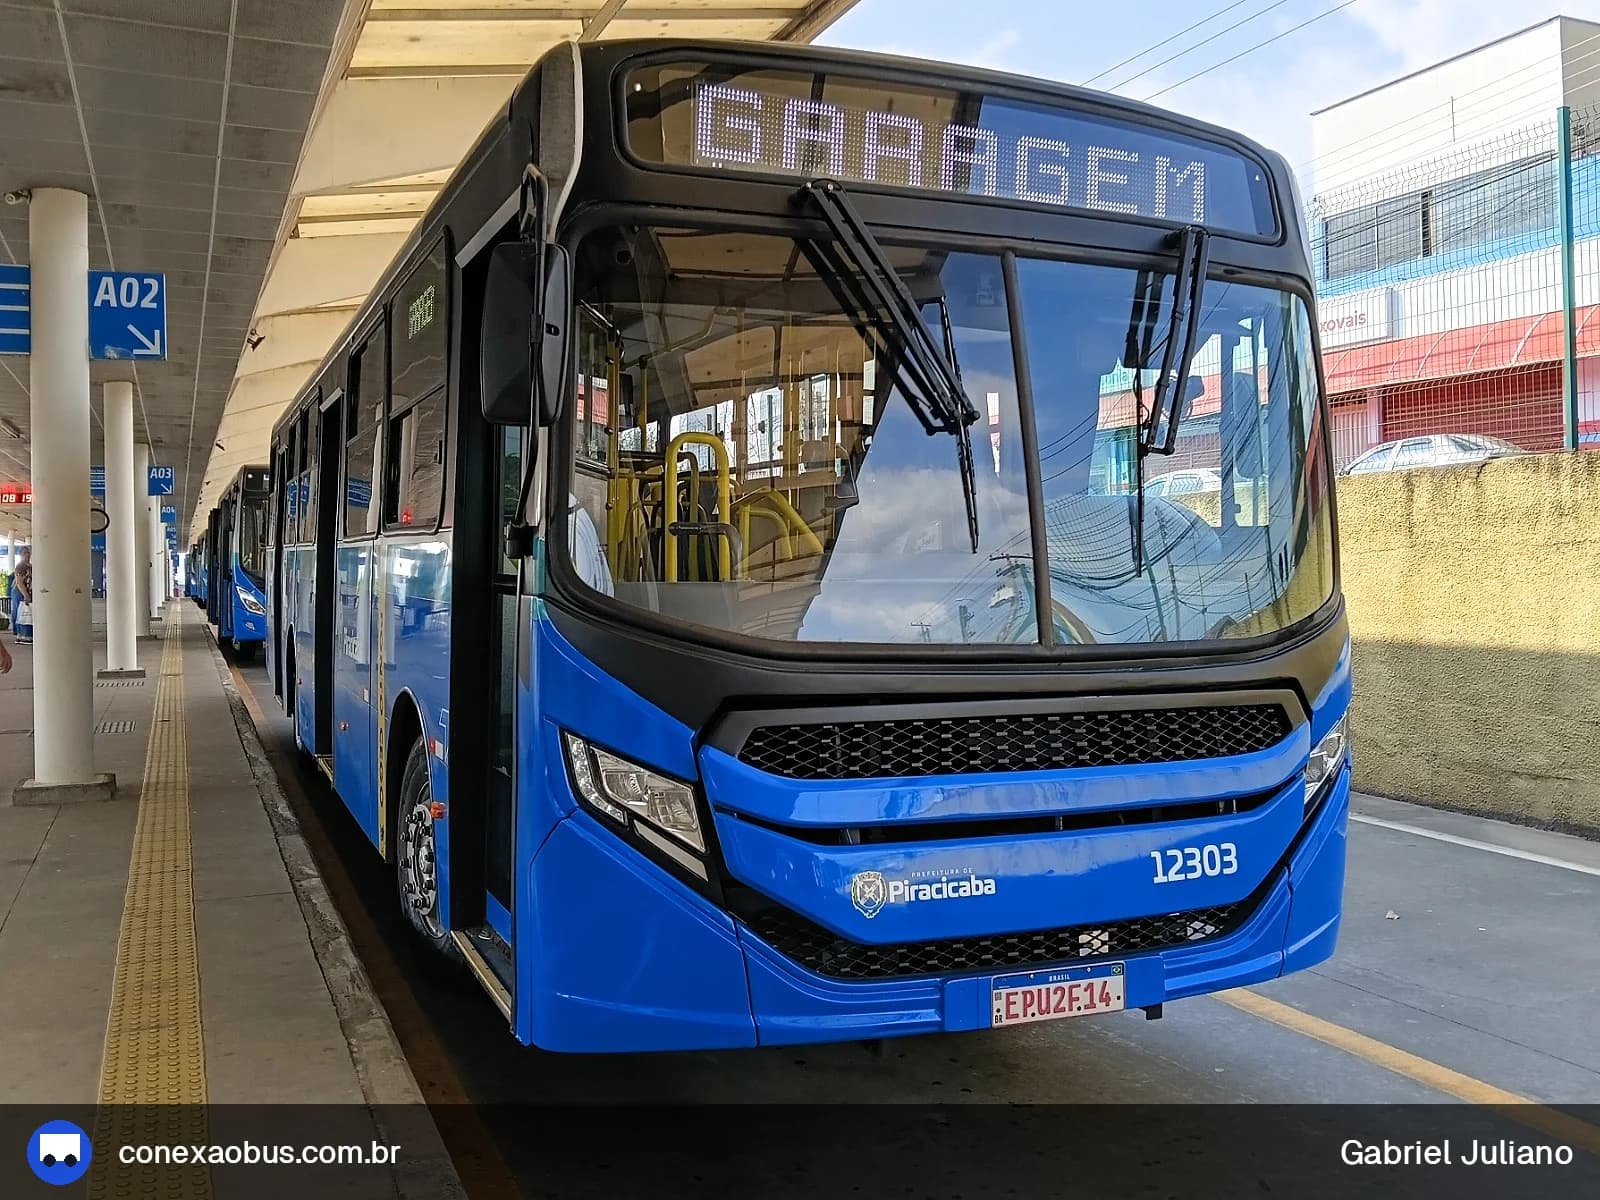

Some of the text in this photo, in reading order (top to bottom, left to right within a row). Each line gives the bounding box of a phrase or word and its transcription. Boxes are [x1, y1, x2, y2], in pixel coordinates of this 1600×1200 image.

[696, 83, 1207, 223] GARAGEM
[93, 276, 159, 309] A02
[150, 467, 172, 479] A03
[911, 869, 960, 878] PREFEITURA
[1150, 842, 1238, 884] 12303
[888, 874, 997, 904] Piracicaba
[1048, 974, 1071, 982] BRASIL
[1005, 980, 1112, 1020] EPU2F14
[994, 1014, 1003, 1024] BR
